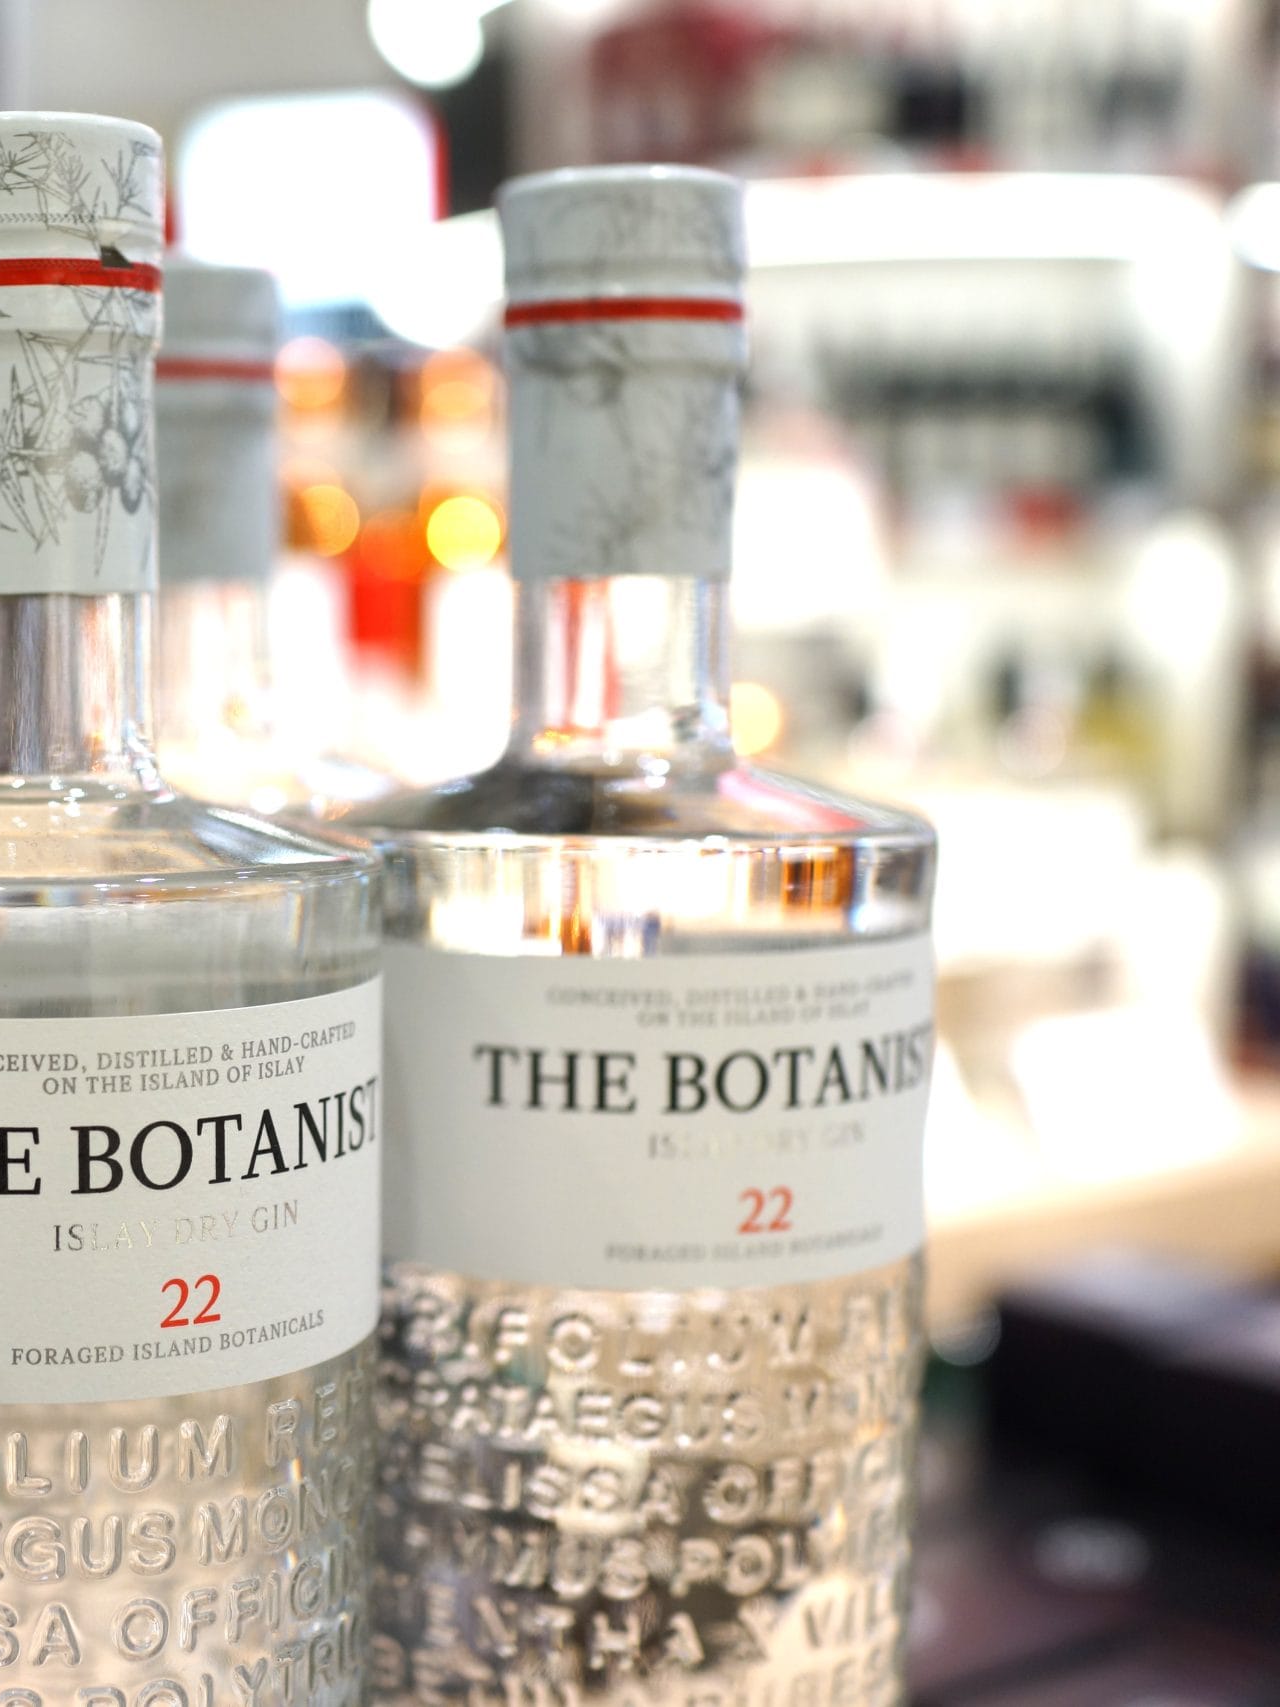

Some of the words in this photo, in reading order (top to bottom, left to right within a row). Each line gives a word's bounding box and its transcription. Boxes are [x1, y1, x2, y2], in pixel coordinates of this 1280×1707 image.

[97, 1046, 213, 1070] DISTILLED
[221, 1043, 234, 1062] &
[241, 1020, 356, 1060] HAND-CRAFTED
[42, 1076, 77, 1095] ON
[86, 1072, 132, 1094] THE
[141, 1067, 220, 1092] ISLAND
[226, 1064, 252, 1084] OF
[258, 1055, 305, 1080] ISLAY
[474, 1043, 636, 1114] THE
[69, 1076, 377, 1196] BOTANIST
[53, 1214, 159, 1252] ISLAY
[174, 1209, 240, 1246] DRY
[251, 1199, 299, 1234] GIN
[736, 1185, 795, 1235] 22
[160, 1273, 221, 1329] 22
[11, 1345, 125, 1366] FORAGED
[131, 1335, 212, 1362] ISLAND
[220, 1308, 325, 1351] BOTANICALS
